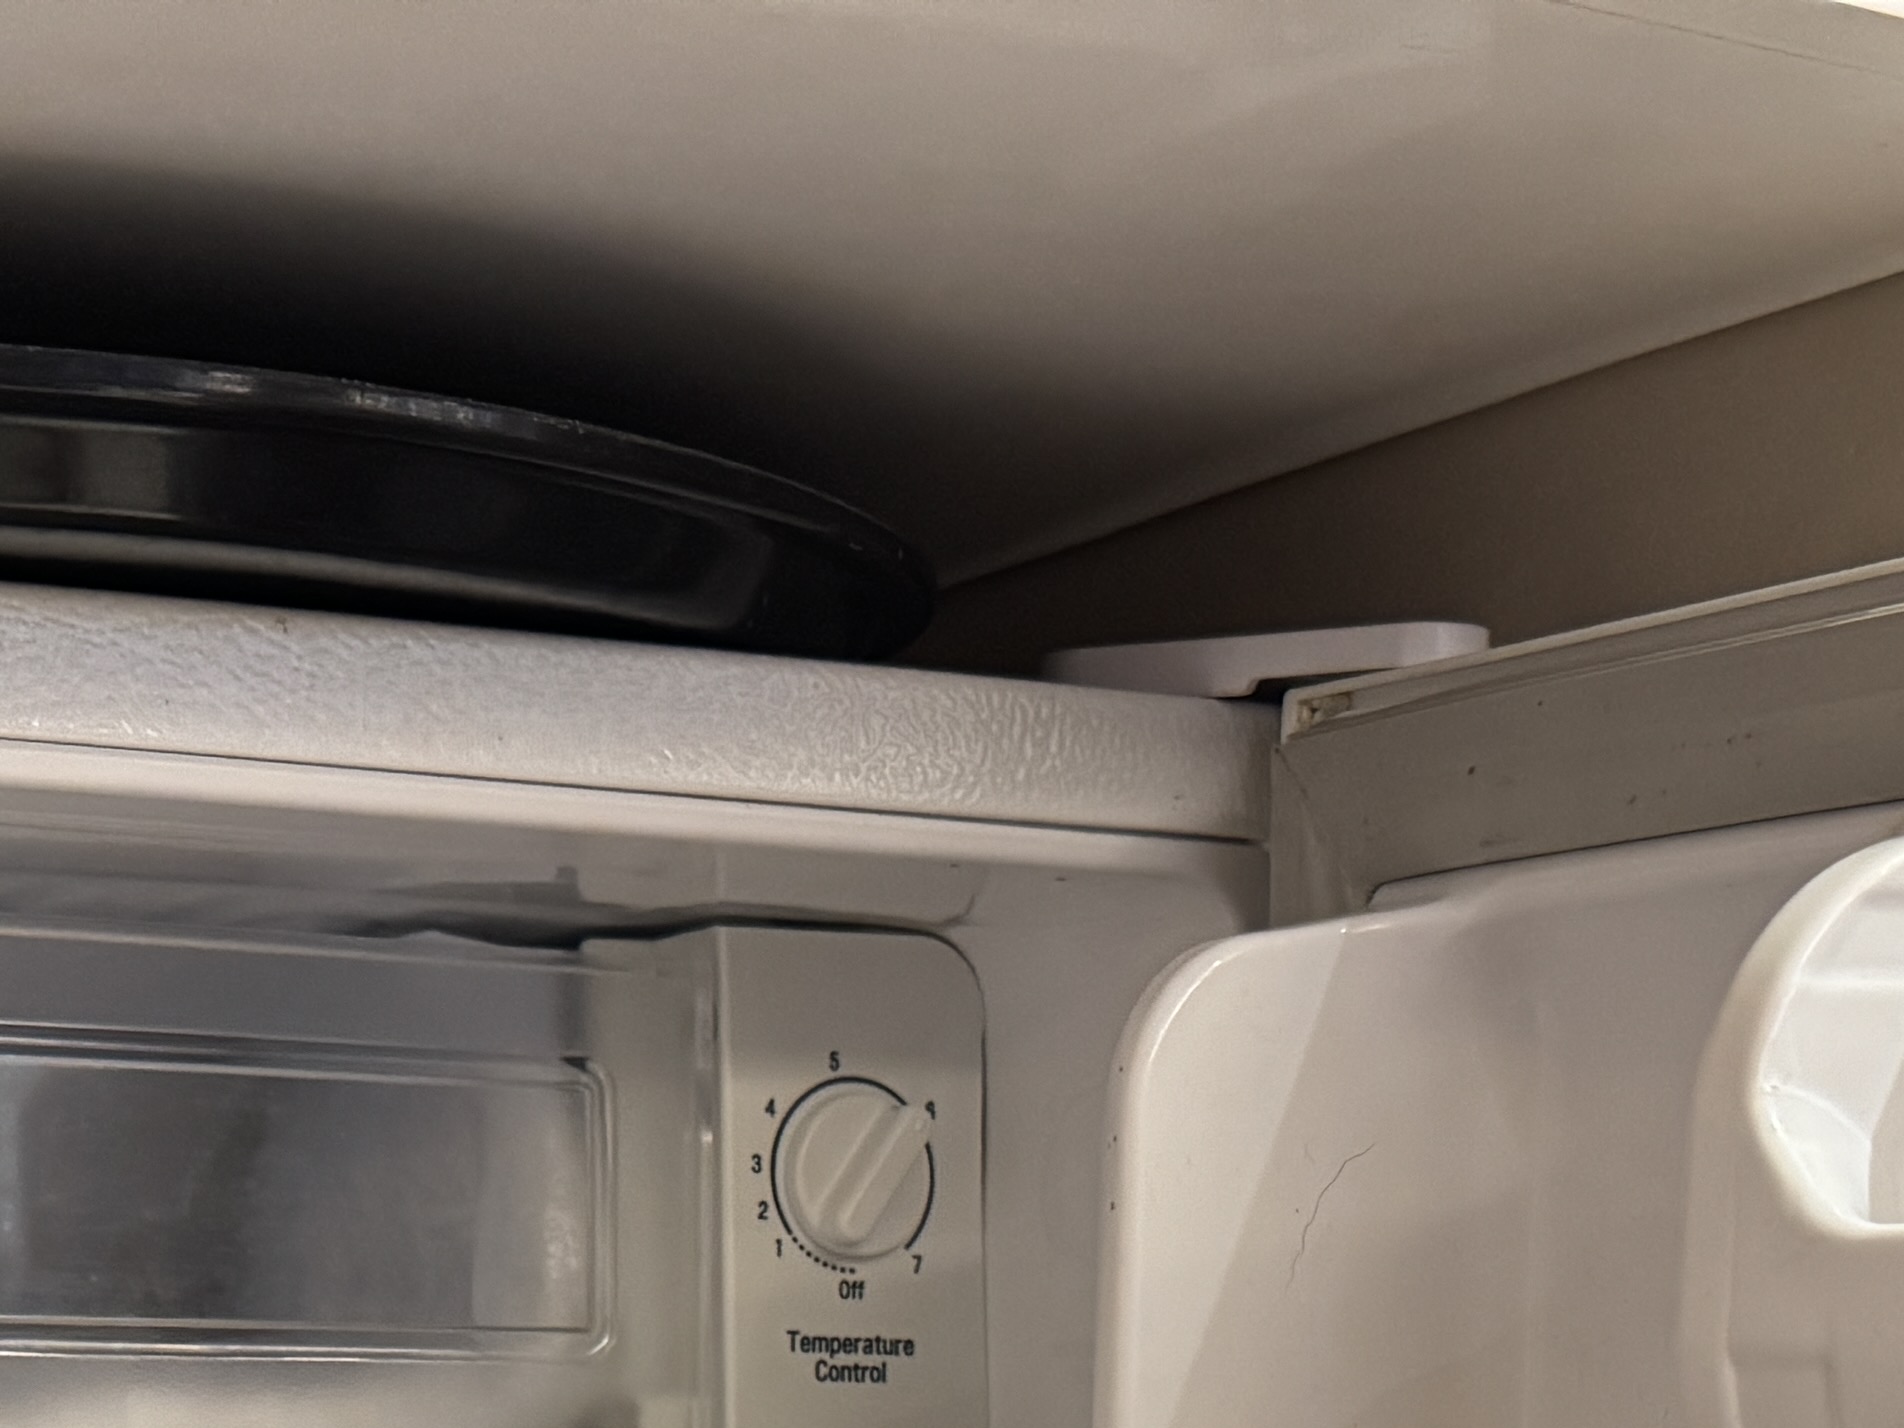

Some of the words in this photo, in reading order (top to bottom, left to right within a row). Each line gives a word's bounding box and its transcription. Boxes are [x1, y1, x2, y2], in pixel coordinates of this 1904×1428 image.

[829, 1052, 840, 1071] 5
[765, 1099, 776, 1118] 4
[751, 1155, 762, 1173] 3
[758, 1203, 768, 1220] 2
[776, 1240, 783, 1257] 1
[913, 1256, 922, 1275] 7
[839, 1281, 865, 1301] Off
[788, 1330, 914, 1357] Temperature
[815, 1360, 886, 1384] Control
